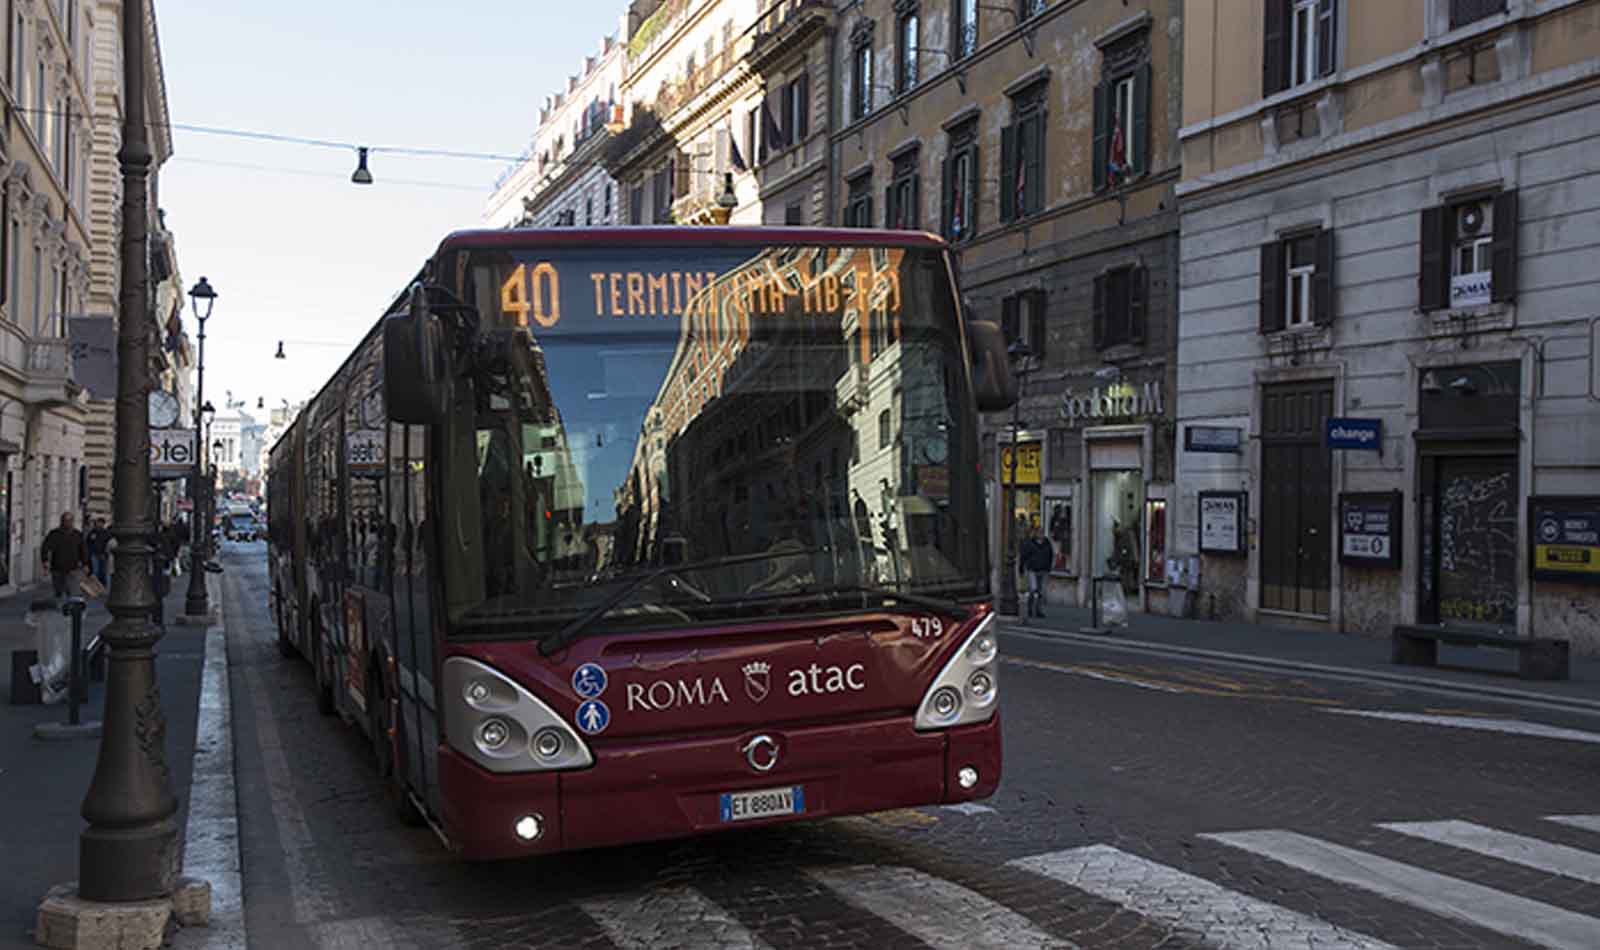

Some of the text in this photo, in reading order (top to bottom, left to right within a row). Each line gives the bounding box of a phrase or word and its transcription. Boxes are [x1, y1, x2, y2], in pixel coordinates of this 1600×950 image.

[500, 261, 561, 327] 40
[590, 271, 718, 316] TERMINI
[1330, 425, 1375, 442] change
[147, 439, 193, 463] otel
[911, 616, 943, 638] 479
[625, 676, 730, 712] ROMA
[787, 661, 866, 697] atac
